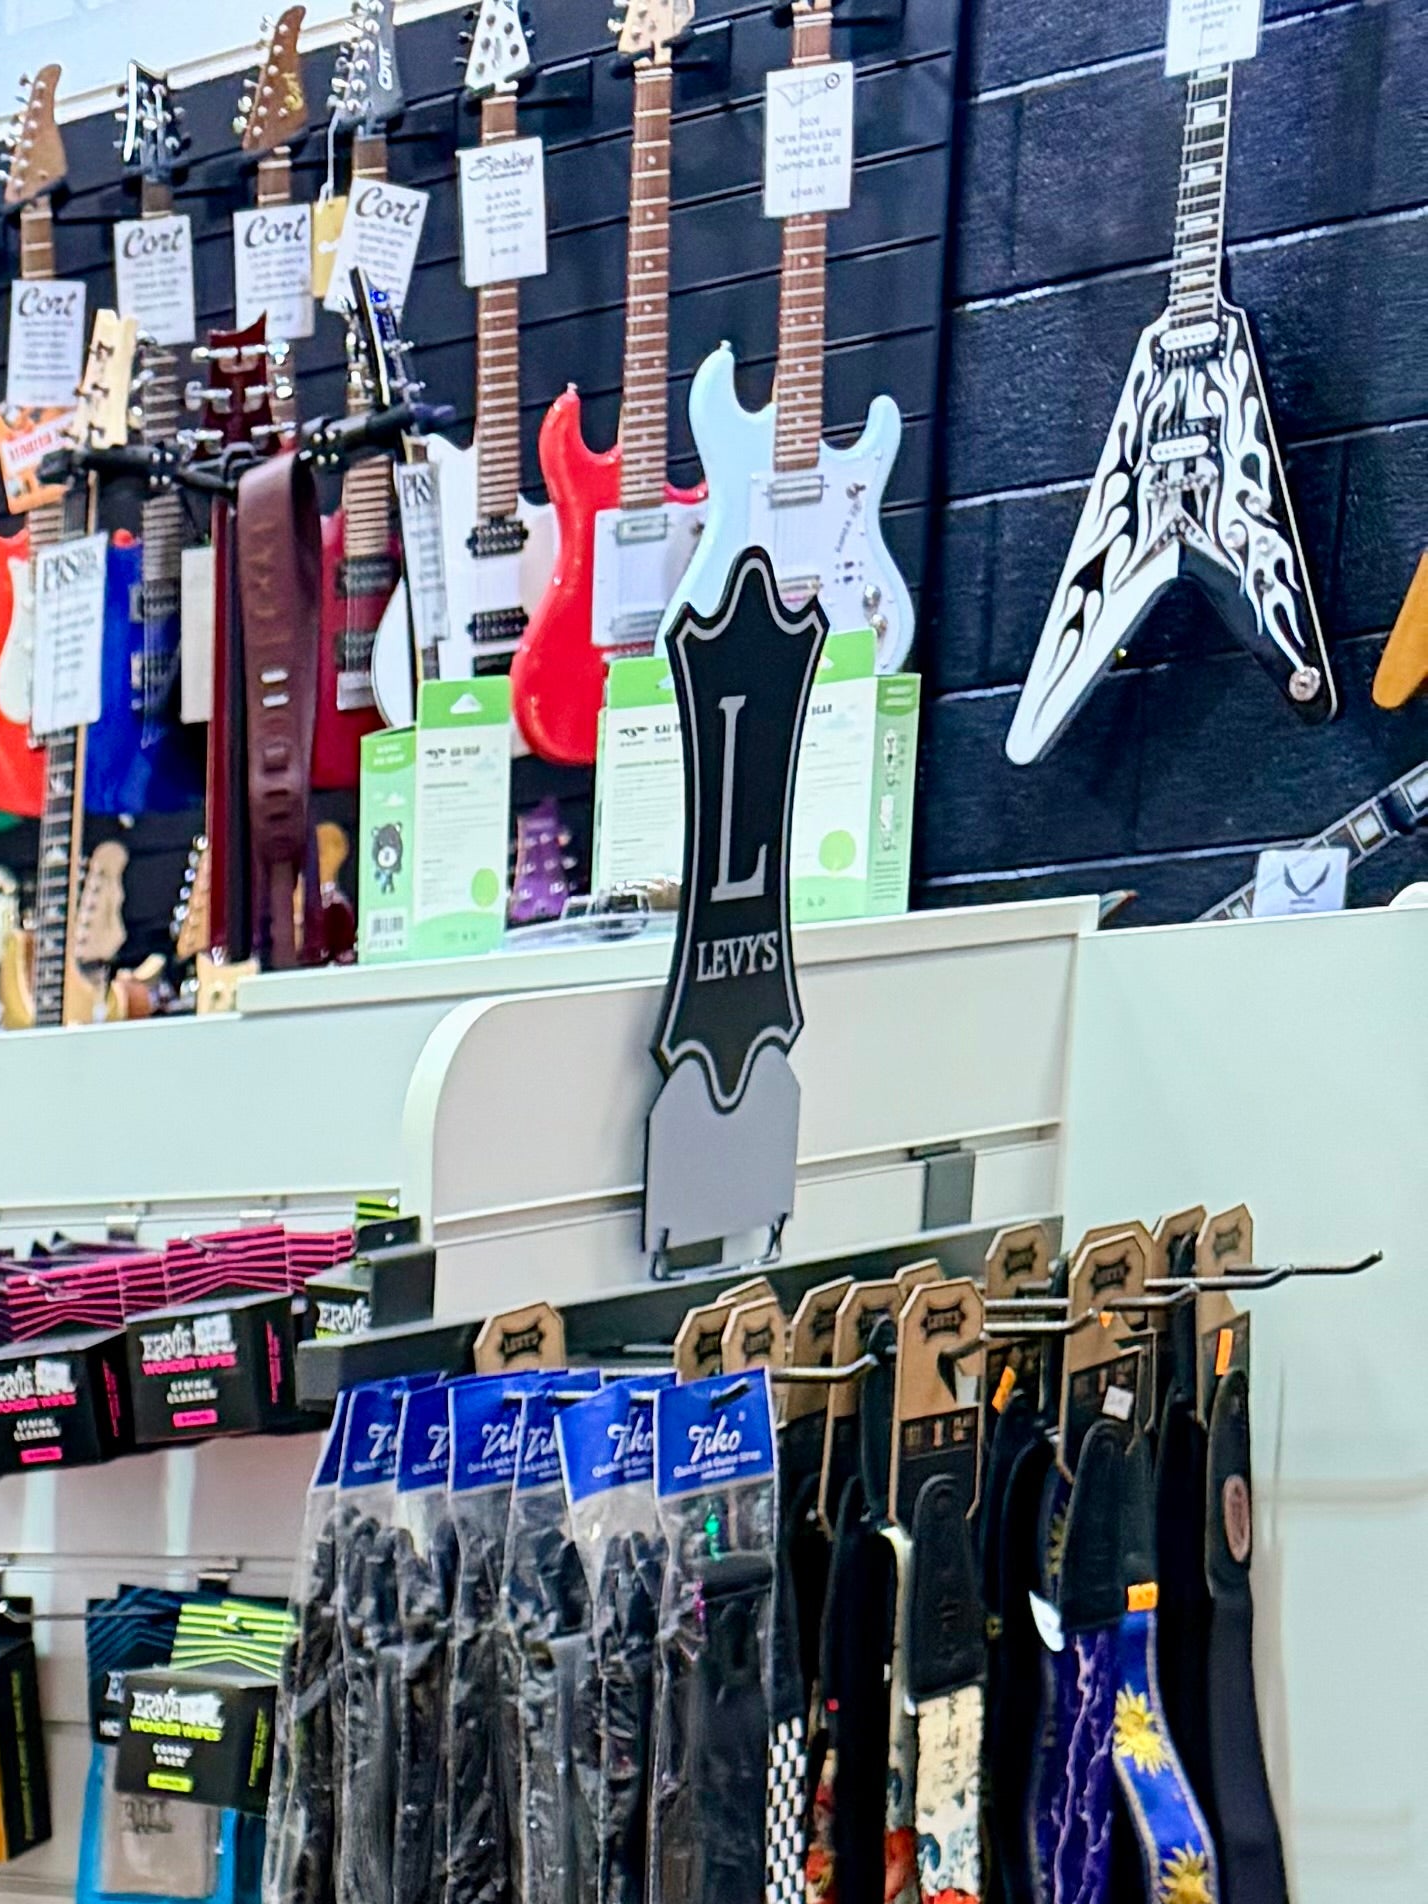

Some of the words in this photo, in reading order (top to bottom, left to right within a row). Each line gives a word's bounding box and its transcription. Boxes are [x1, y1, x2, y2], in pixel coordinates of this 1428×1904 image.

[355, 186, 420, 227] Cort
[122, 221, 185, 260] Cort
[244, 212, 307, 249] Cort
[18, 287, 78, 318] Cort
[710, 695, 767, 902] L
